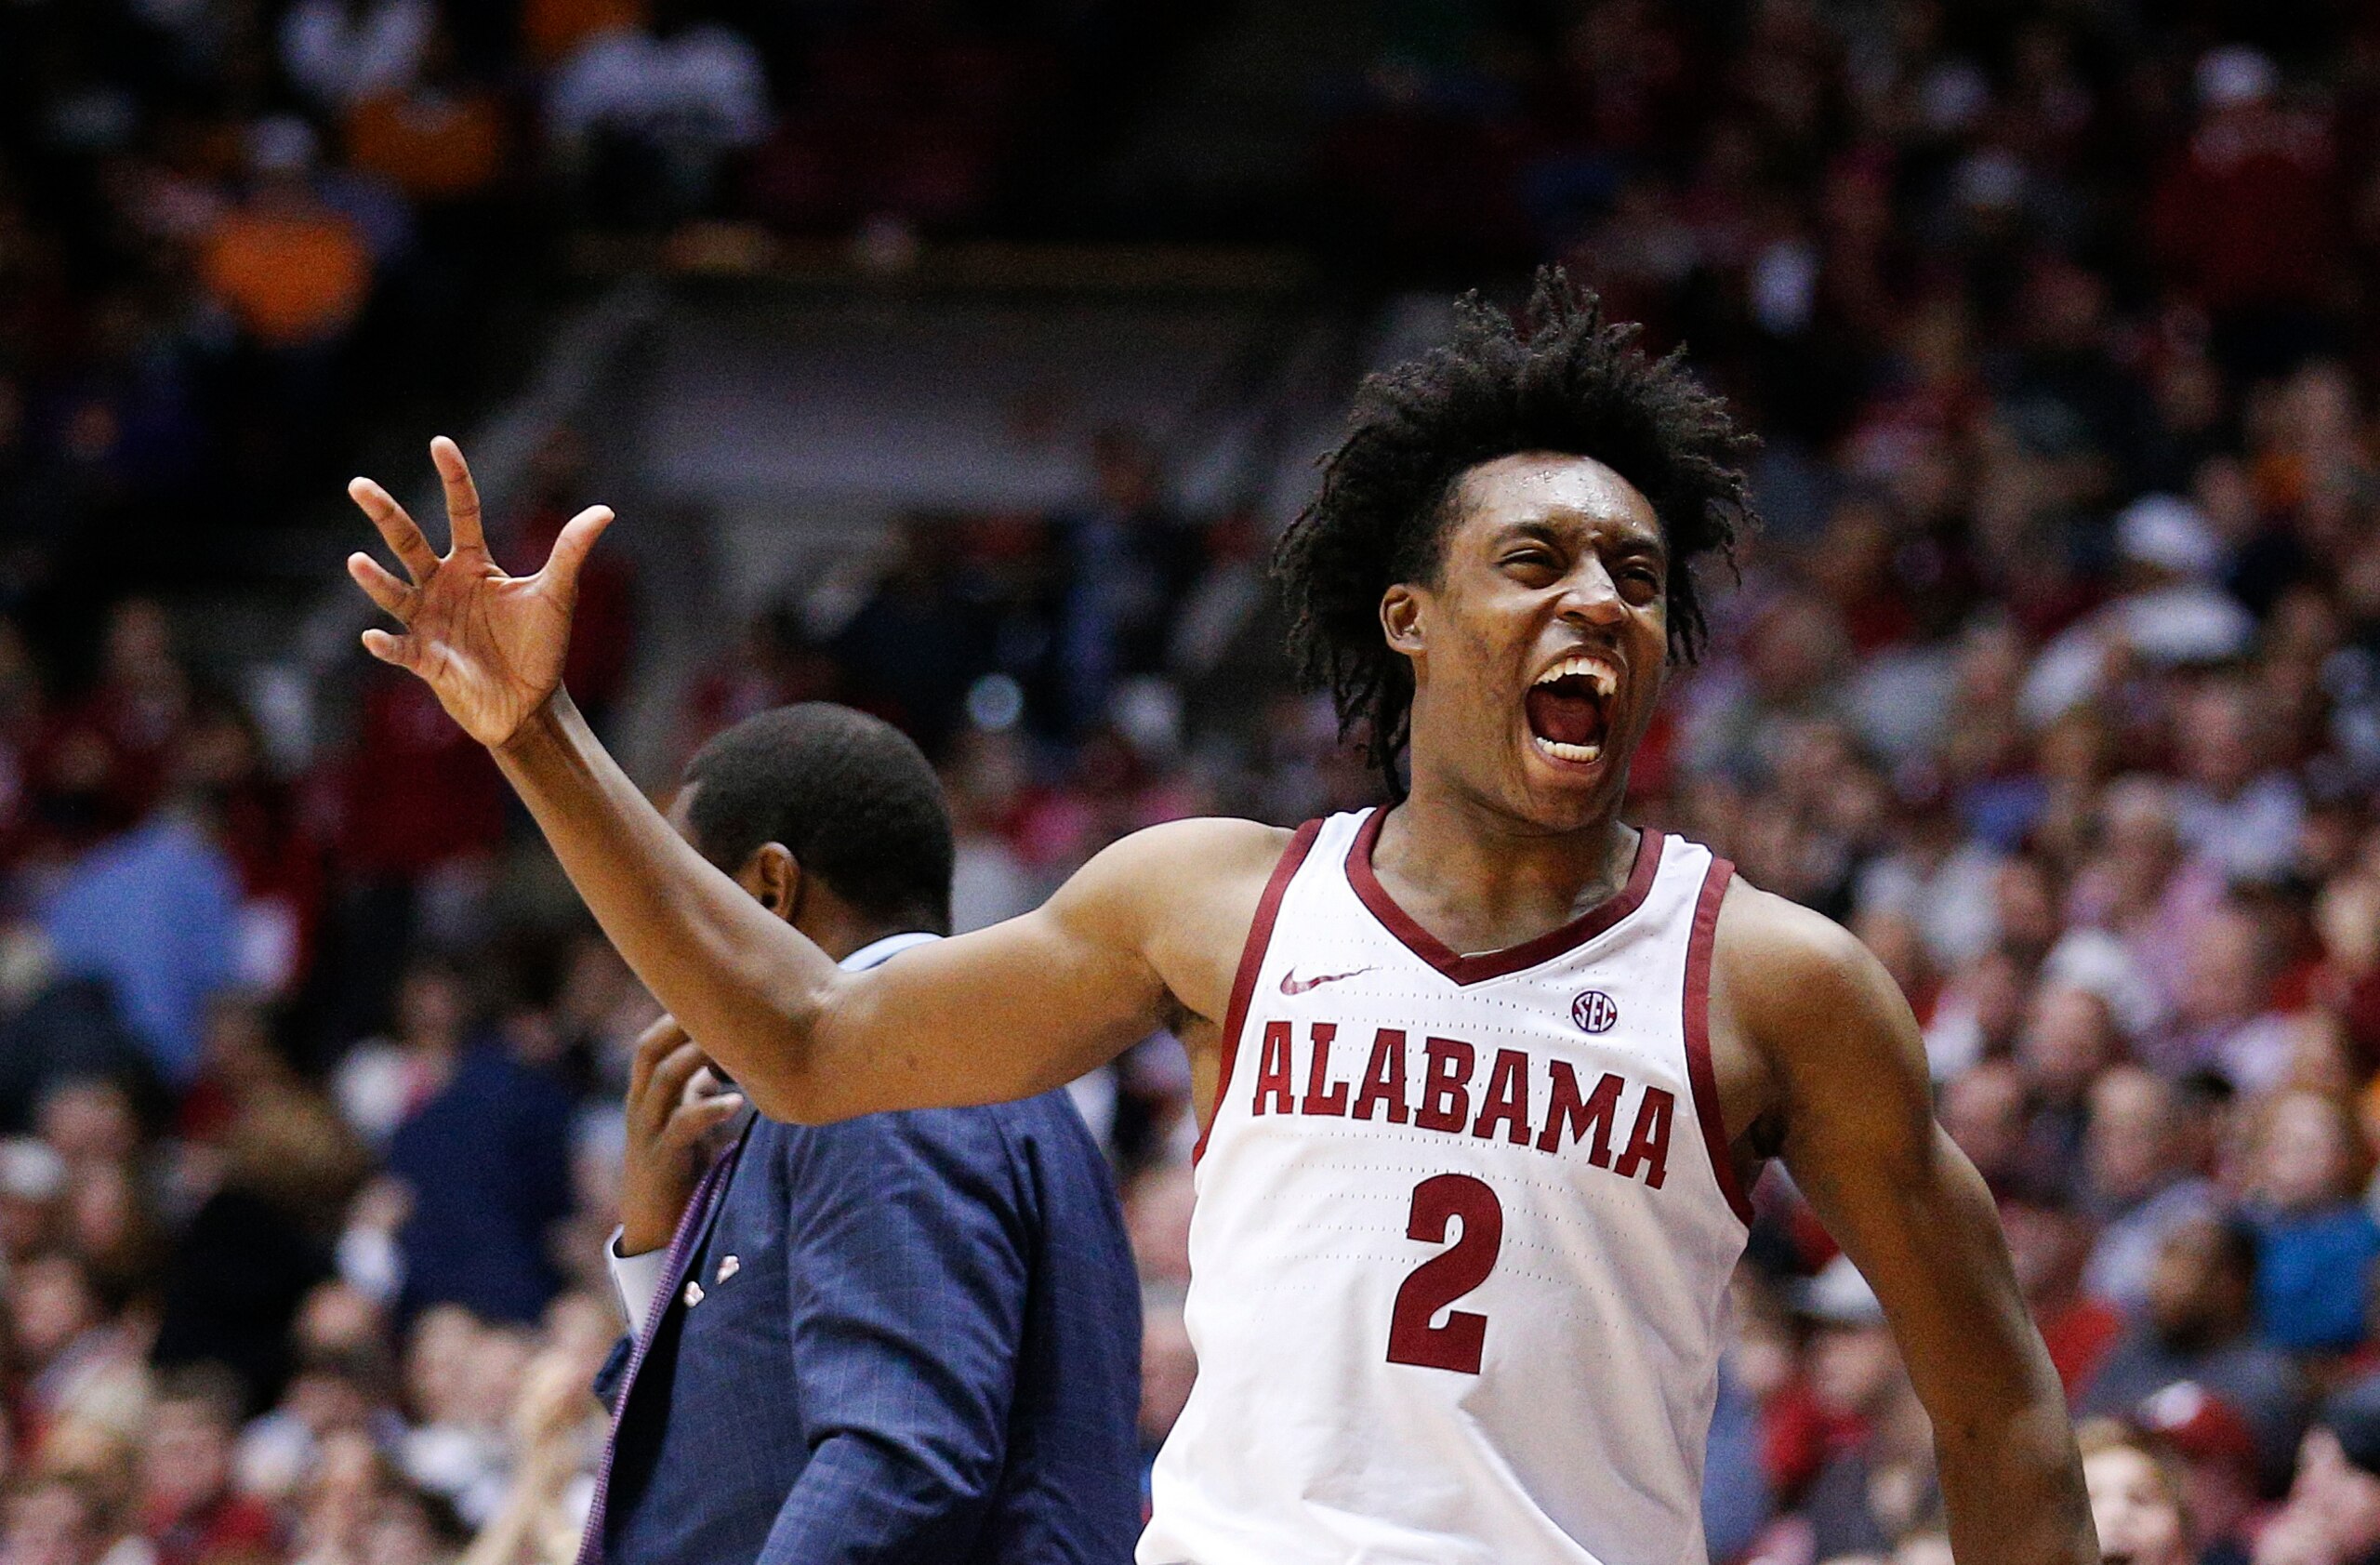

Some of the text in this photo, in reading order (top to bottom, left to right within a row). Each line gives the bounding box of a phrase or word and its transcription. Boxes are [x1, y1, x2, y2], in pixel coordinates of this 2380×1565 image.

[1573, 991, 1617, 1032] SEC
[1252, 1020, 1675, 1189] ALABAMA
[1386, 1173, 1502, 1374] 2
